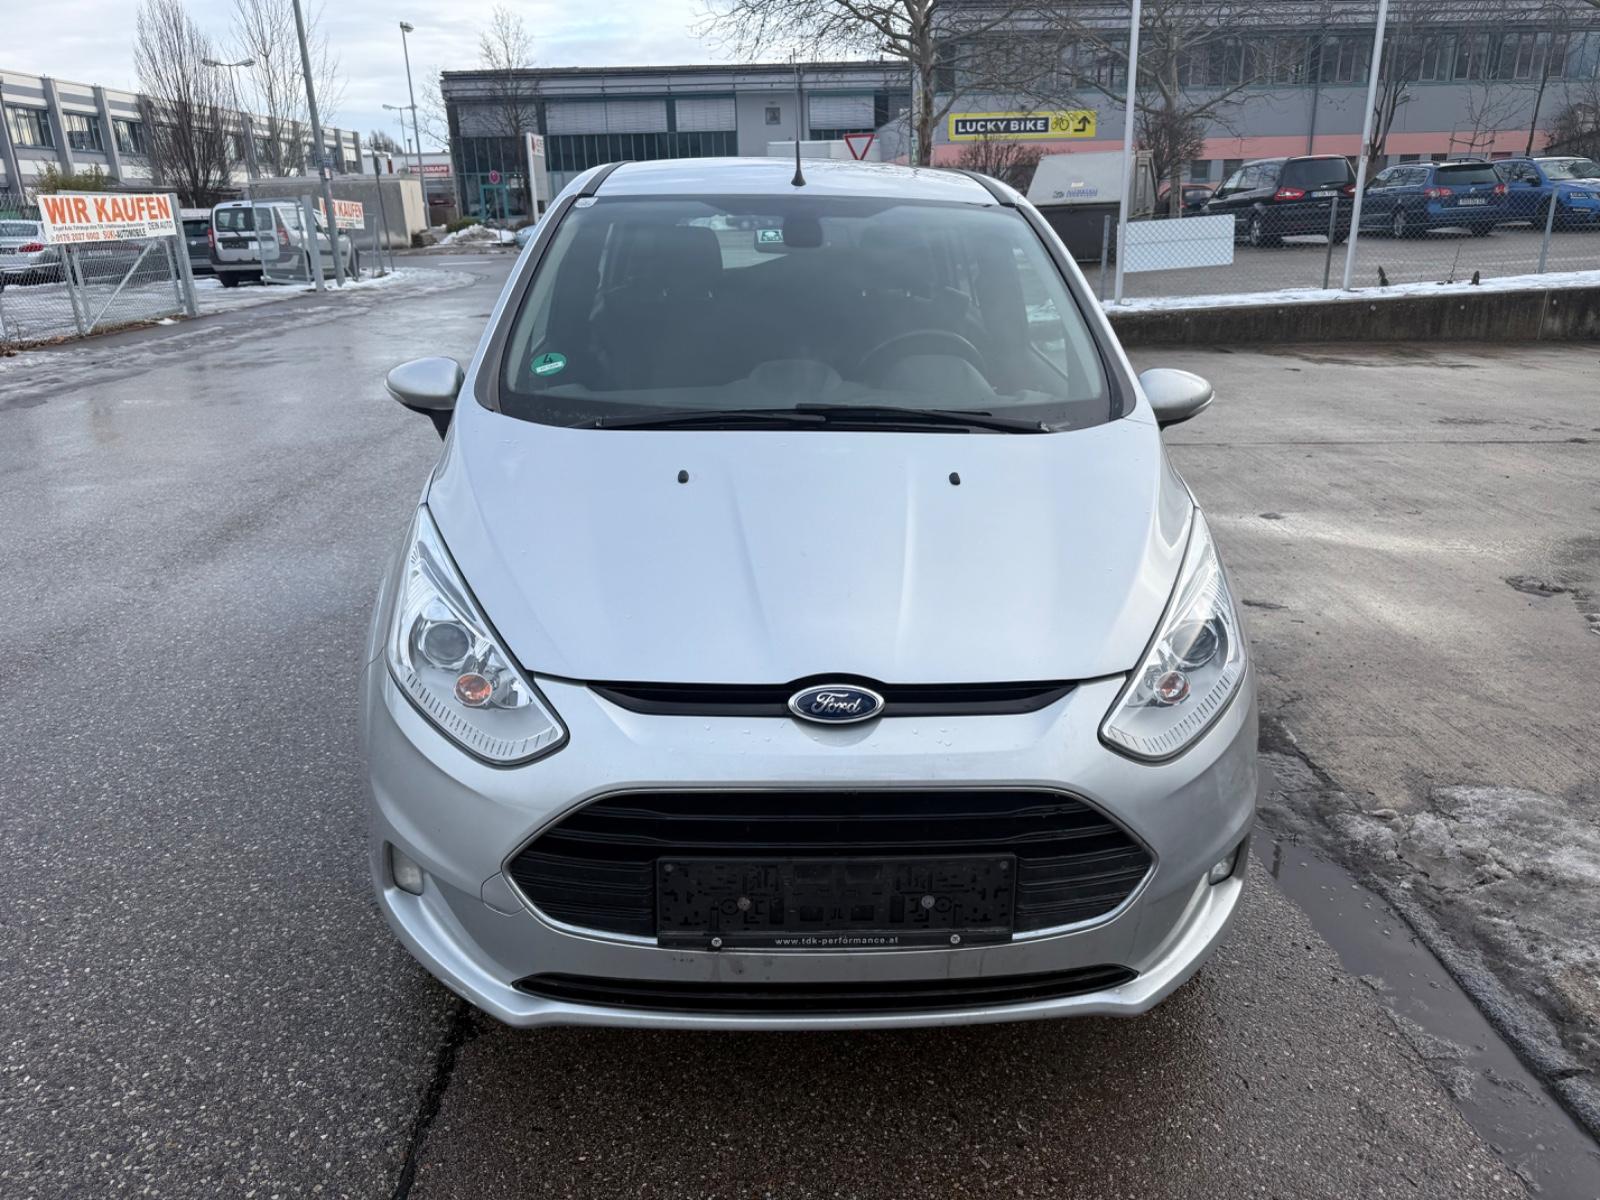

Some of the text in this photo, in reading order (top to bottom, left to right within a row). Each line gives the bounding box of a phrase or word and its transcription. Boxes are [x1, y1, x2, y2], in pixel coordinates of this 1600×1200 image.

[958, 120, 1045, 132] LUCKY BIKE
[43, 196, 170, 224] WIR KAUFEN
[543, 354, 553, 364] 4
[811, 692, 861, 713] Ford
[775, 936, 899, 946] www.tdk-performance.at
